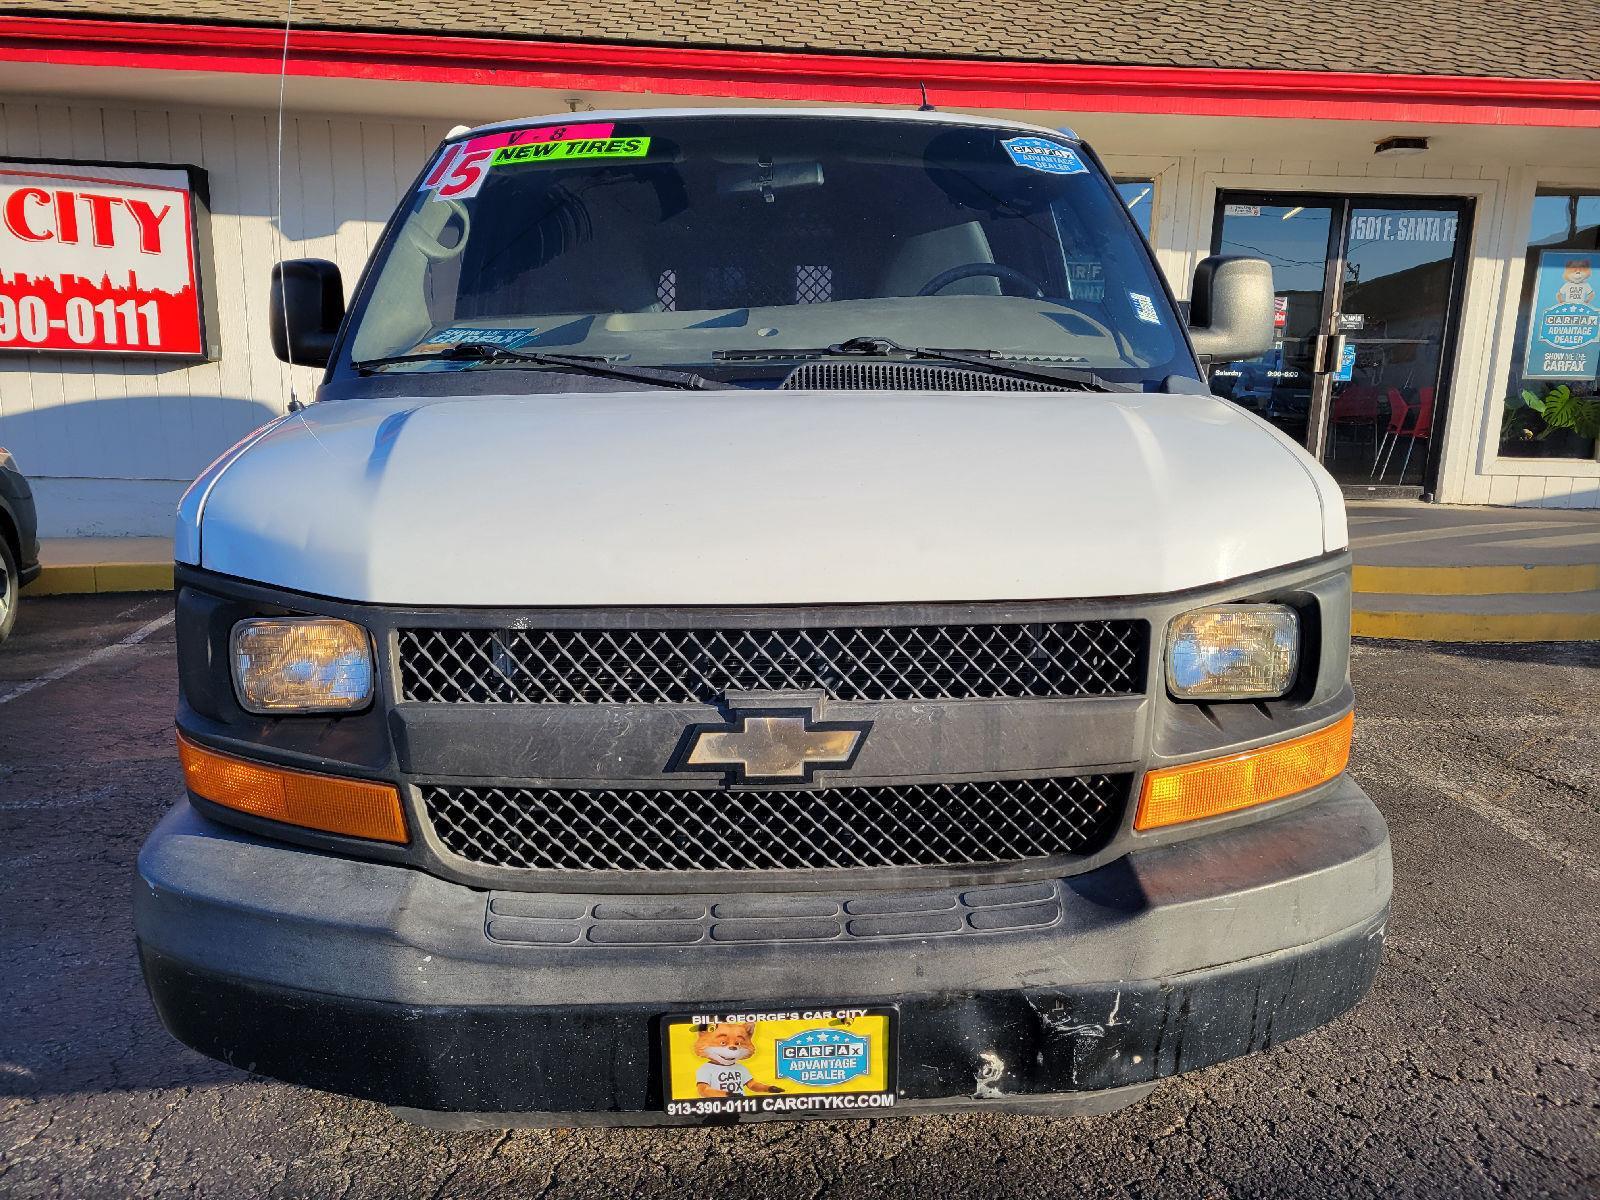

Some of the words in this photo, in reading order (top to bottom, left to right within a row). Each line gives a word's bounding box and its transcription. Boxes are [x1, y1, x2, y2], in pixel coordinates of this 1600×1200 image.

[507, 131, 526, 144] V
[549, 128, 567, 141] 8
[495, 142, 560, 162] NEW
[566, 138, 642, 155] TIRES
[1011, 145, 1075, 159] CARFAX
[1023, 154, 1075, 166] ADVANTAGE
[1035, 162, 1071, 170] DEALER
[426, 144, 493, 196] 15
[4, 187, 171, 256] CITY
[1350, 215, 1382, 240] 1501
[1397, 217, 1441, 242] SANTA
[1442, 218, 1459, 242] FE
[1547, 316, 1598, 325] CARFAX
[1548, 326, 1592, 335] ADVANTAGE
[1554, 336, 1584, 344] DEALER
[1544, 352, 1565, 361] SHOW
[1543, 361, 1586, 371] CARFAX
[1214, 369, 1243, 378] Saturday
[692, 1015, 722, 1025] BILL
[725, 1012, 800, 1024] GEORGE'S
[802, 1010, 833, 1020] CAR
[836, 1009, 868, 1019] CITY
[784, 1045, 863, 1058] CARFAX
[789, 1058, 857, 1071] ADVANTAGE
[718, 1072, 742, 1082] CAR
[801, 1069, 846, 1081] DEALER
[720, 1082, 743, 1093] FOX
[667, 1099, 758, 1116] 913-390-0111
[762, 1094, 895, 1111] CARCITYKC.COM
